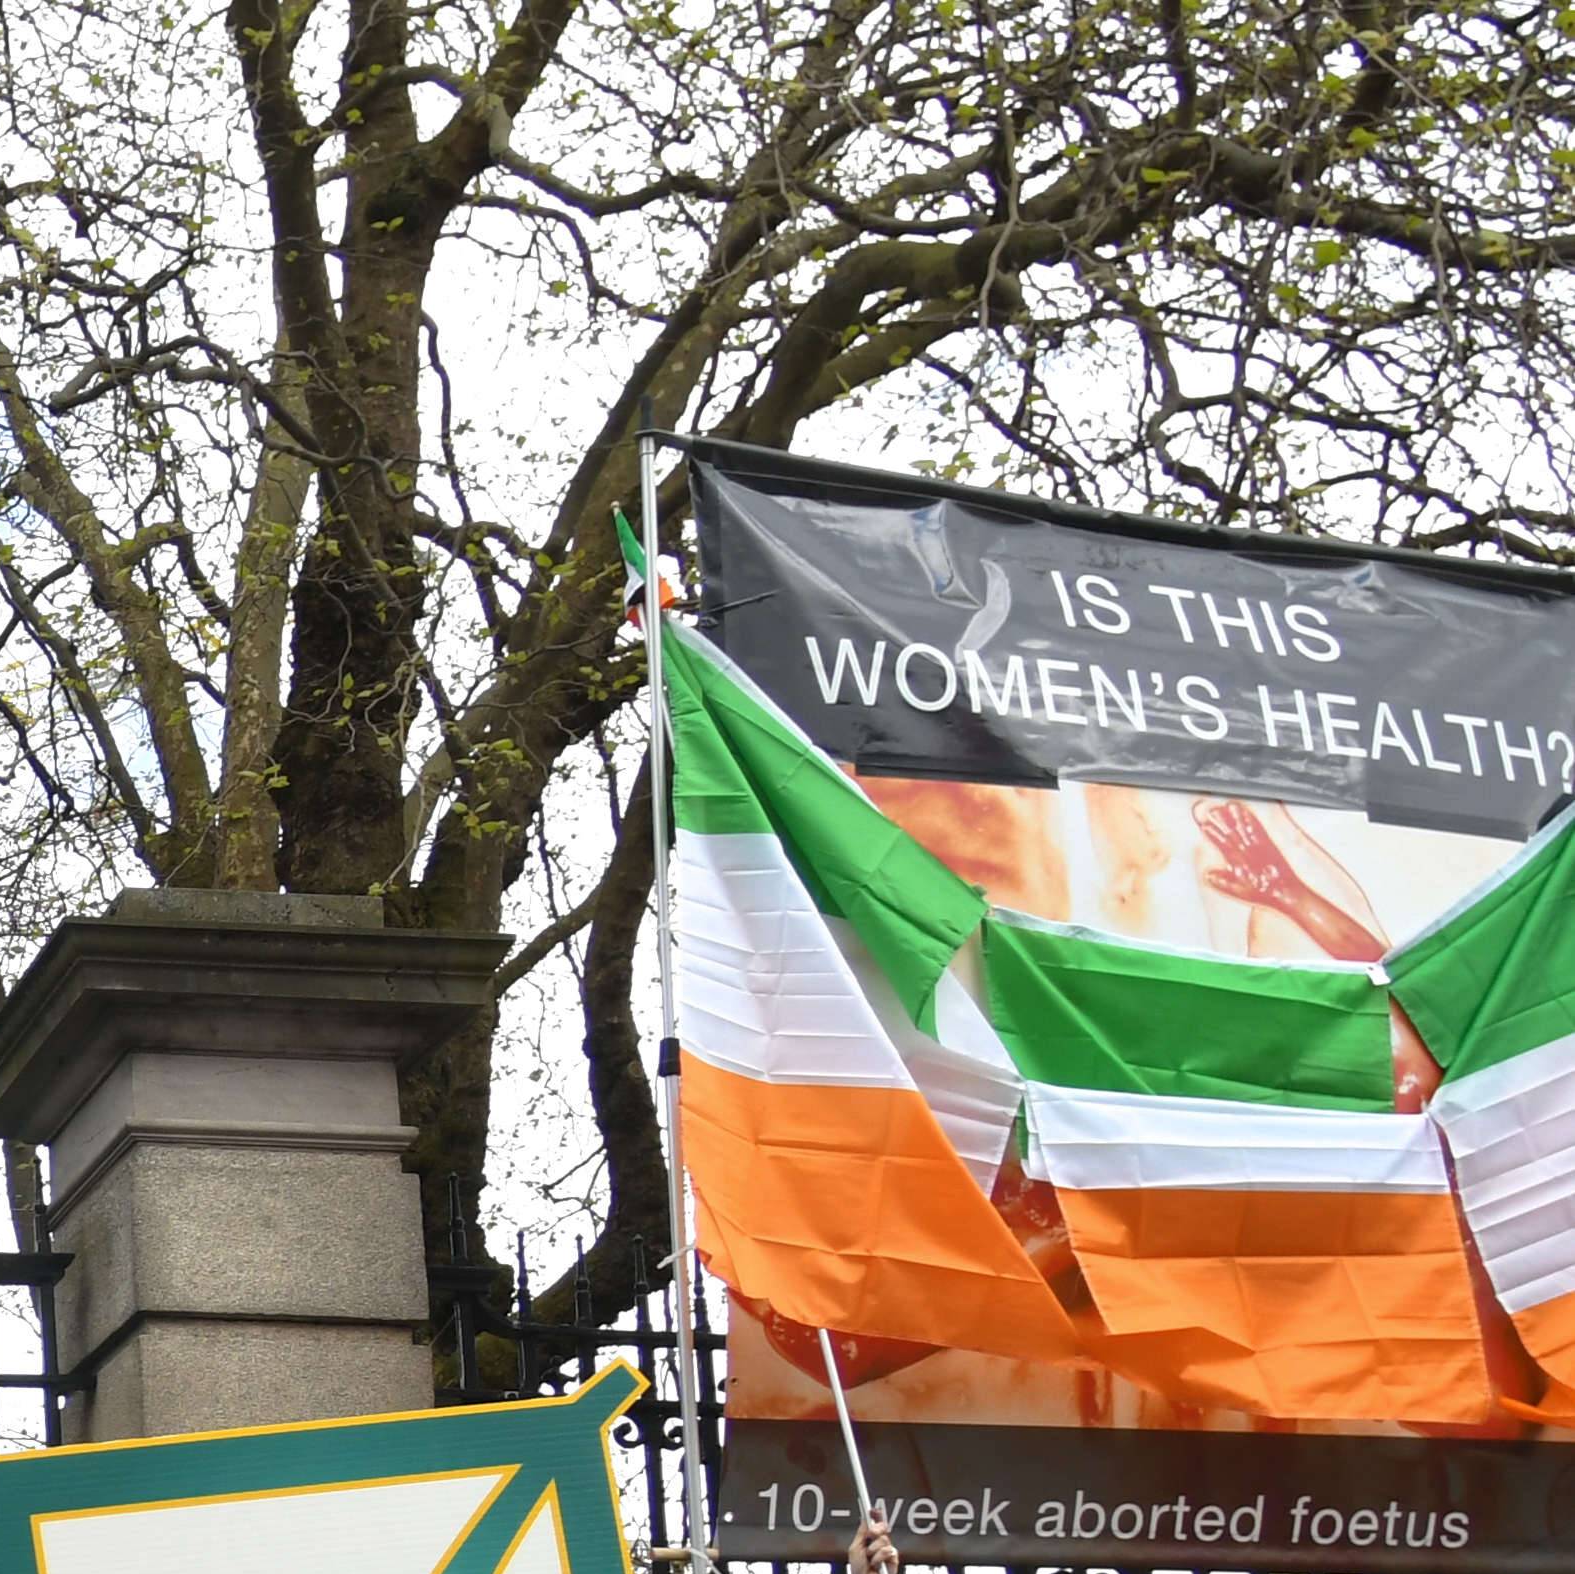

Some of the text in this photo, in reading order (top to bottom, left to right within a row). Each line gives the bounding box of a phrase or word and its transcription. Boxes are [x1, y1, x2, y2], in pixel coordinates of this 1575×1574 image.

[1051, 569, 1341, 662] IS THIS
[805, 636, 1575, 794] WOMEN’S HEALTH?
[757, 1484, 1470, 1549] 10-week aborted foetus
